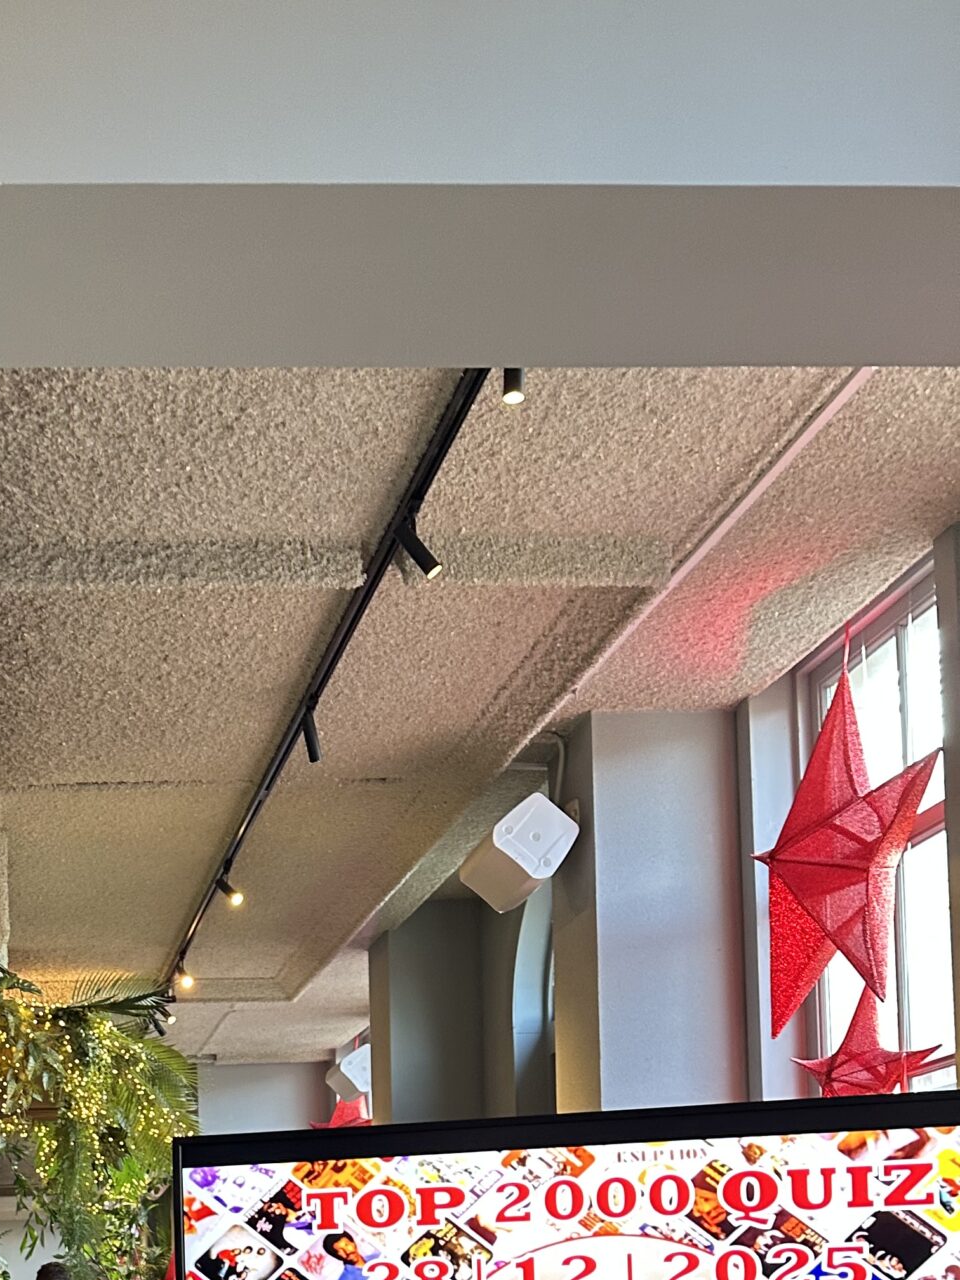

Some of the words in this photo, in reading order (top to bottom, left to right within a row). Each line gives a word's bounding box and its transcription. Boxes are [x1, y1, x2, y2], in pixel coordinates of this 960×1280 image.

[306, 1186, 466, 1231] TOP
[495, 1174, 690, 1223] 2000
[722, 1162, 935, 1225] QUIZ
